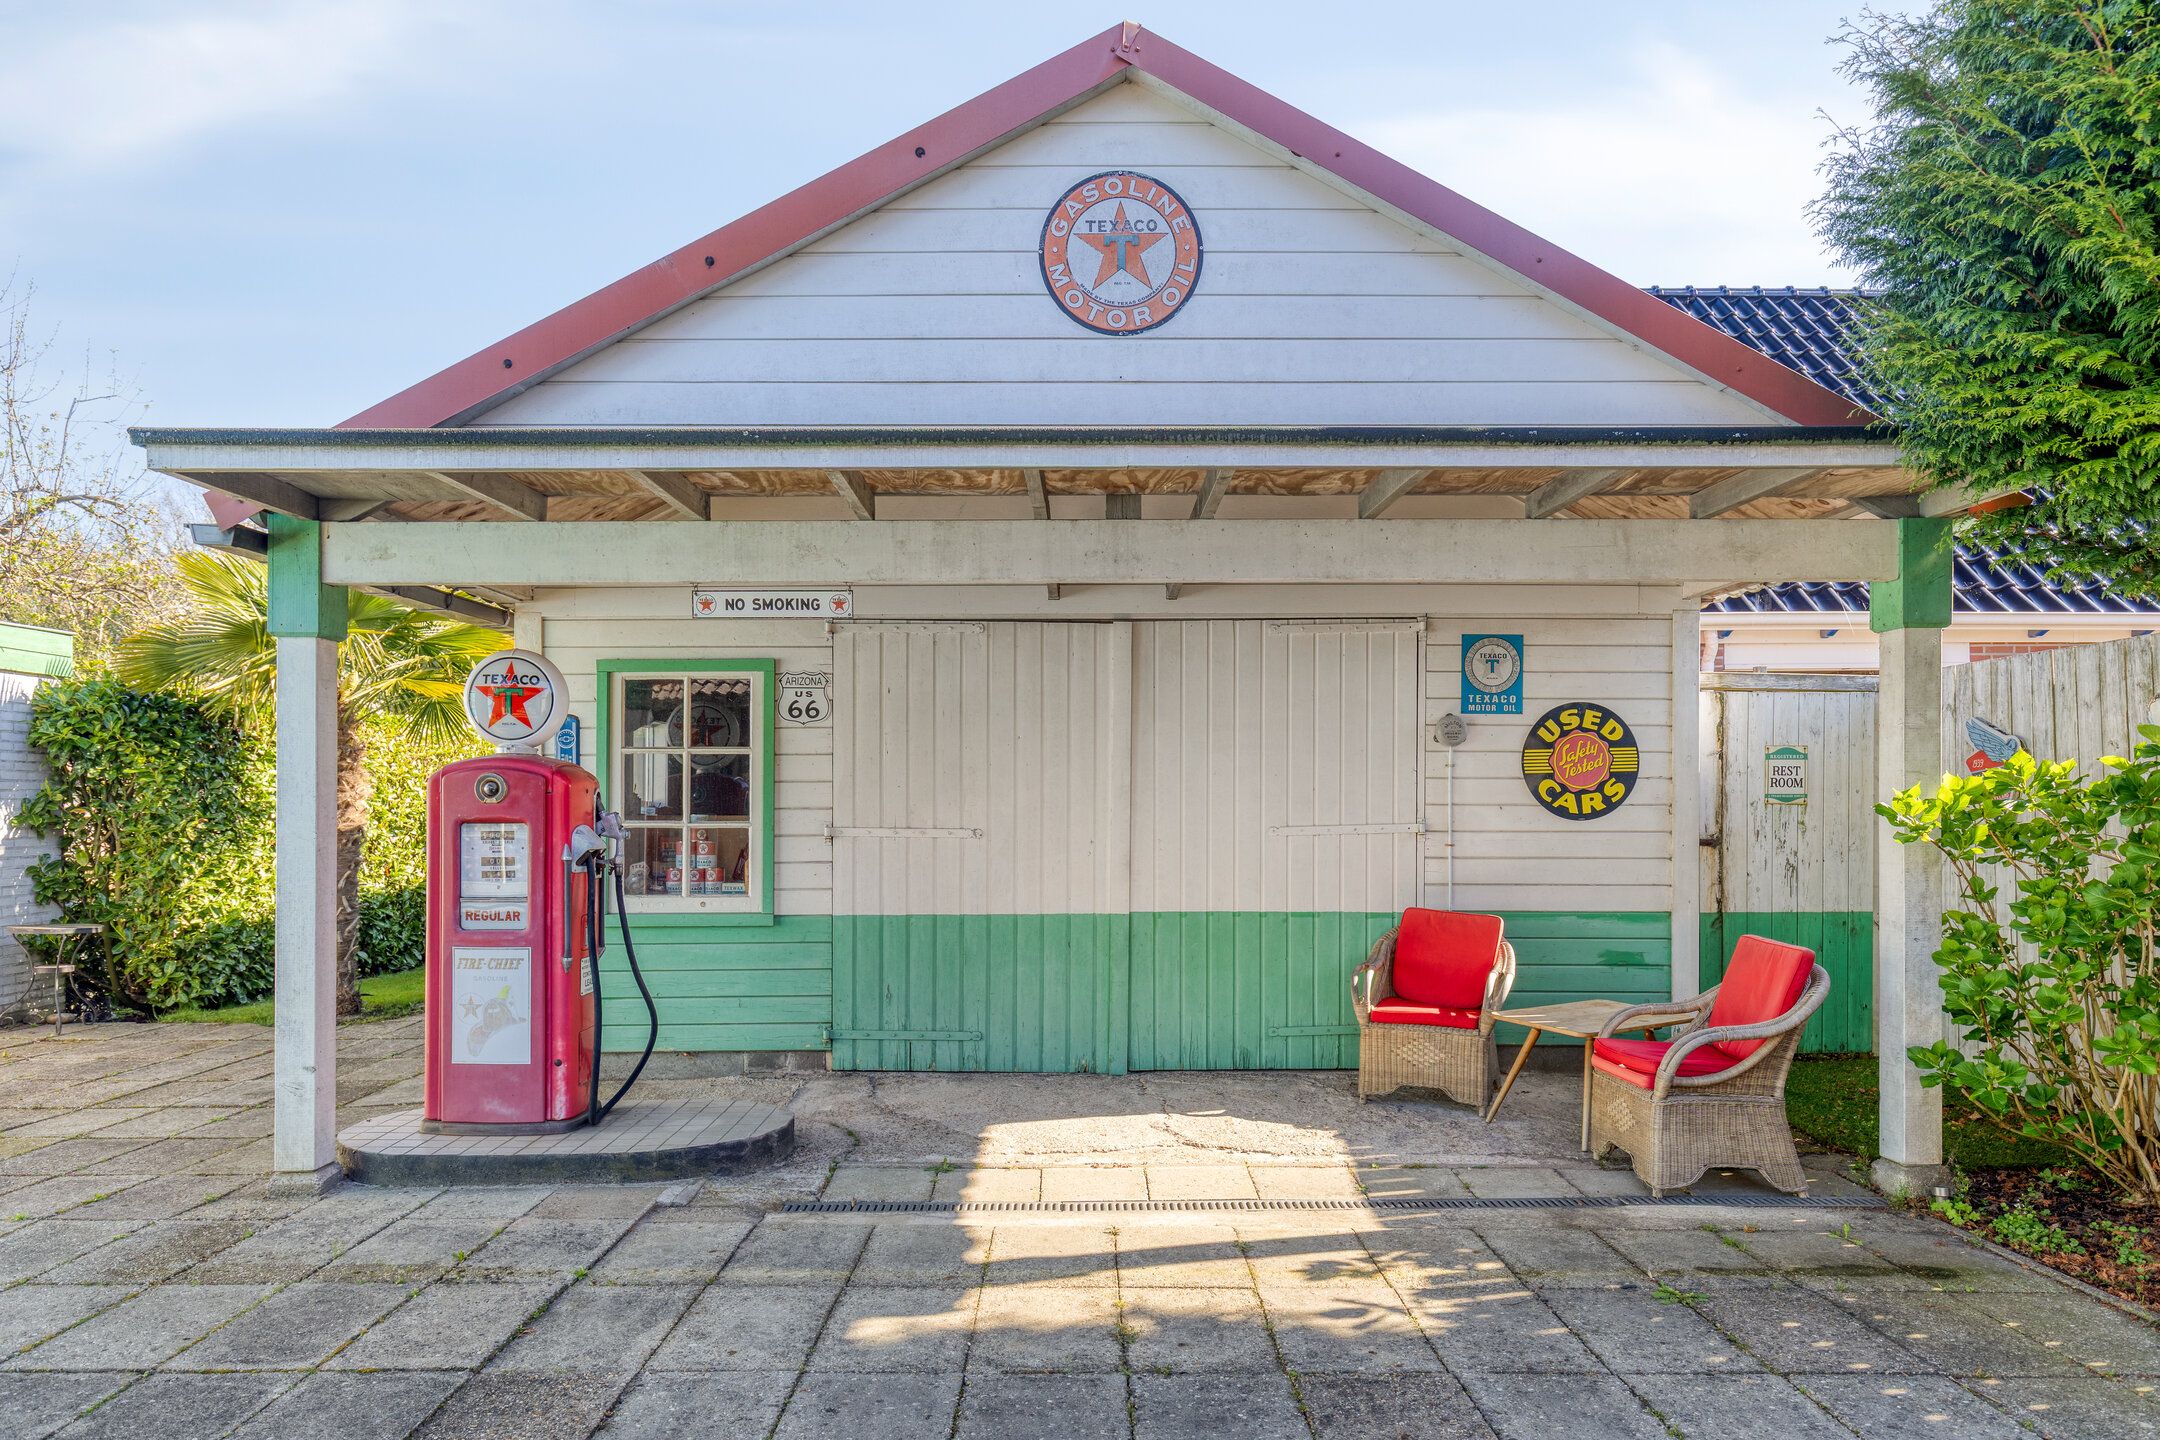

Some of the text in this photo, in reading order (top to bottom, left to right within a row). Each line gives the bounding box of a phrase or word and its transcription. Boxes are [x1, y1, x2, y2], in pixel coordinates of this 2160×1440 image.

[1050, 177, 1191, 238] GASOLINE
[1085, 219, 1158, 233] TEXACO
[1103, 235, 1140, 270] T
[1048, 257, 1196, 328] MOTOR OIL
[1080, 283, 1094, 296] MADE
[725, 598, 820, 610] NO SMOKING
[1486, 659, 1500, 674] T
[482, 674, 540, 686] TEXACO
[785, 676, 823, 686] ARIZONA
[495, 688, 524, 715] T
[1468, 694, 1516, 703] TEXACO
[788, 700, 820, 719] 66
[1537, 709, 1624, 743] USED
[1560, 740, 1598, 766] Safety
[1563, 753, 1604, 778] Tested
[1772, 766, 1801, 776] REST
[1770, 778, 1803, 788] ROOM
[1538, 778, 1626, 814] CARS
[465, 910, 520, 921] REGULAR
[457, 958, 524, 970] FIRE-CHIEF
